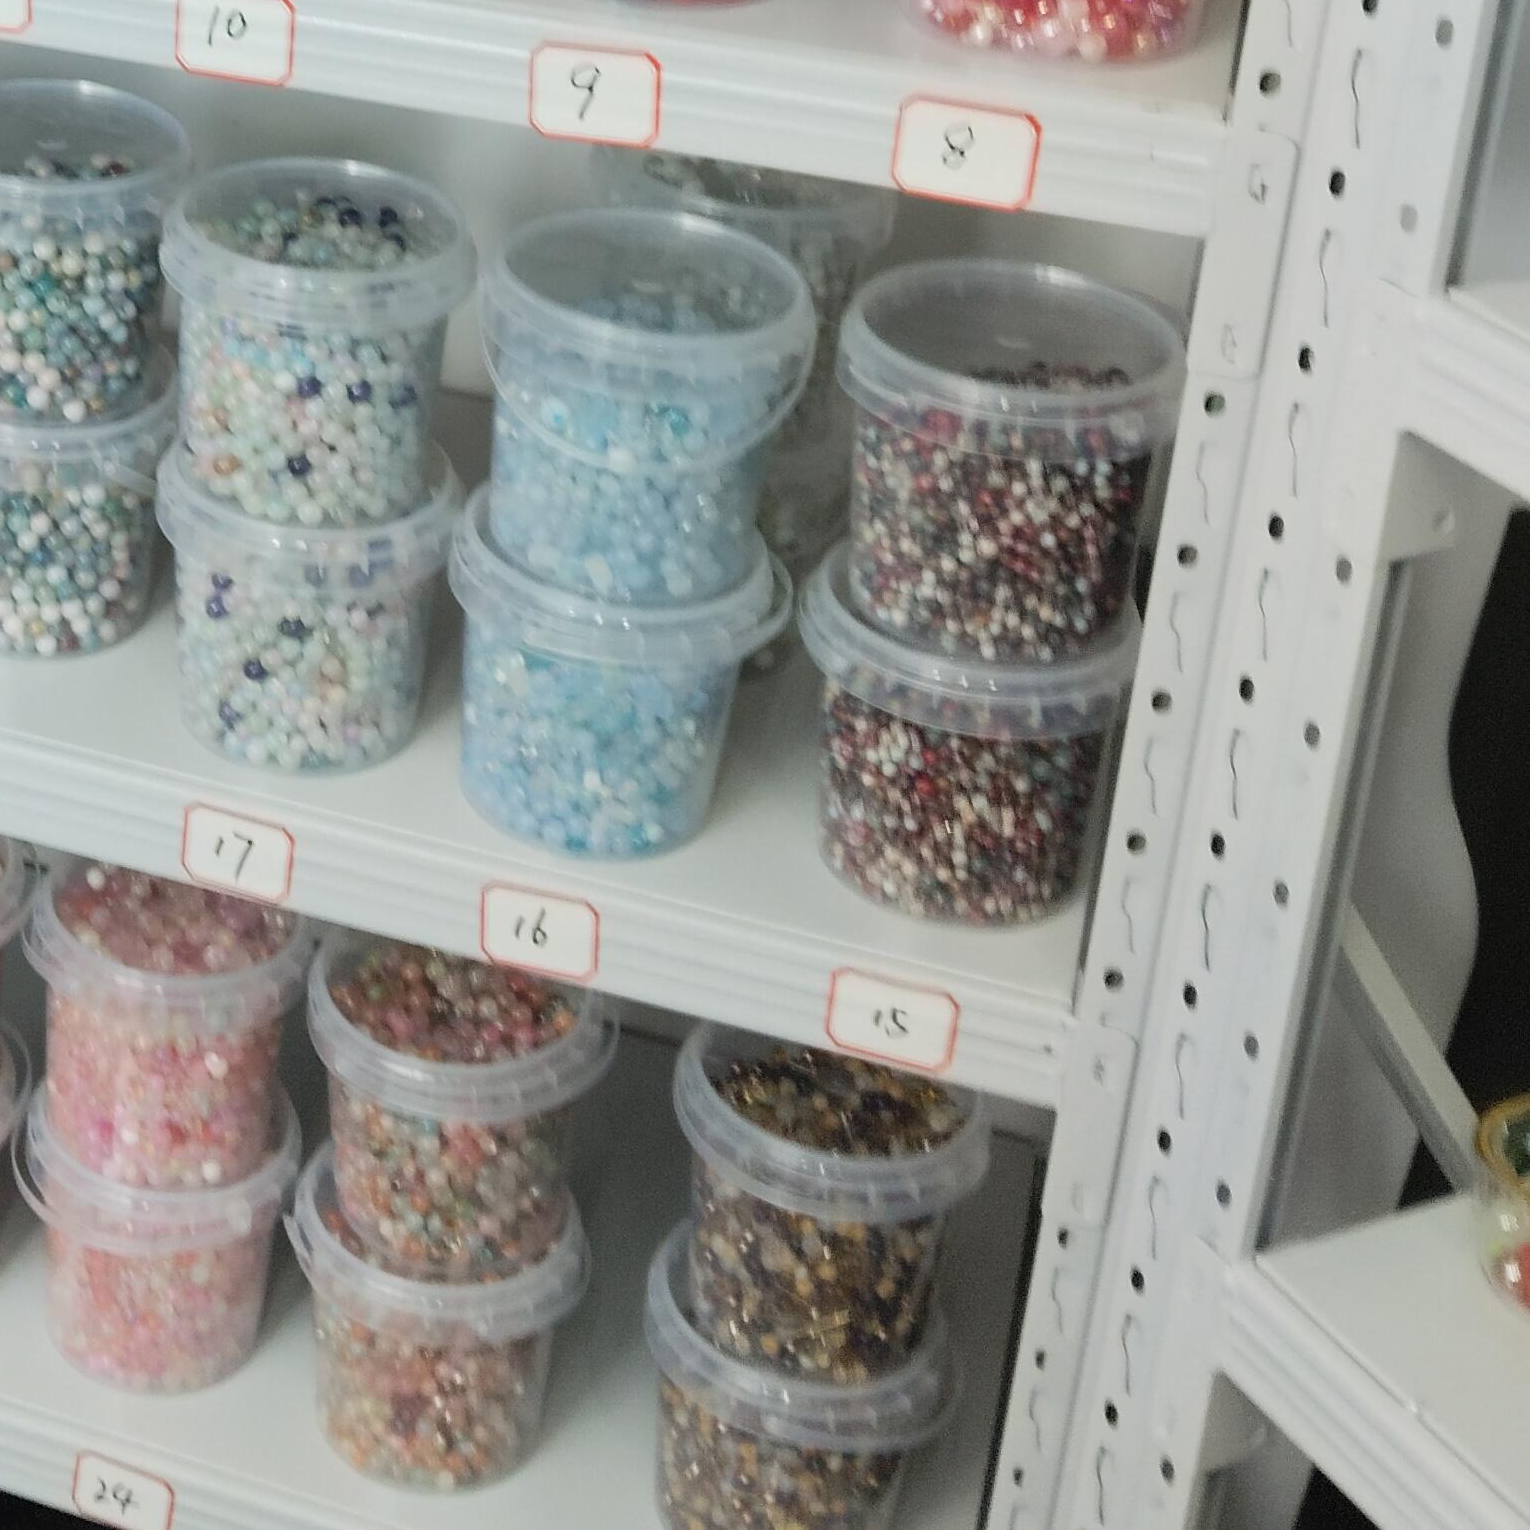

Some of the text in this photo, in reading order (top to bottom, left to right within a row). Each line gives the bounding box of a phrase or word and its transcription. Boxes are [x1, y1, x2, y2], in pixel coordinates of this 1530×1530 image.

[207, 6, 247, 47] 10
[570, 64, 600, 121] 9
[943, 125, 974, 170] 8
[215, 830, 253, 883] 17
[515, 907, 549, 946] 16
